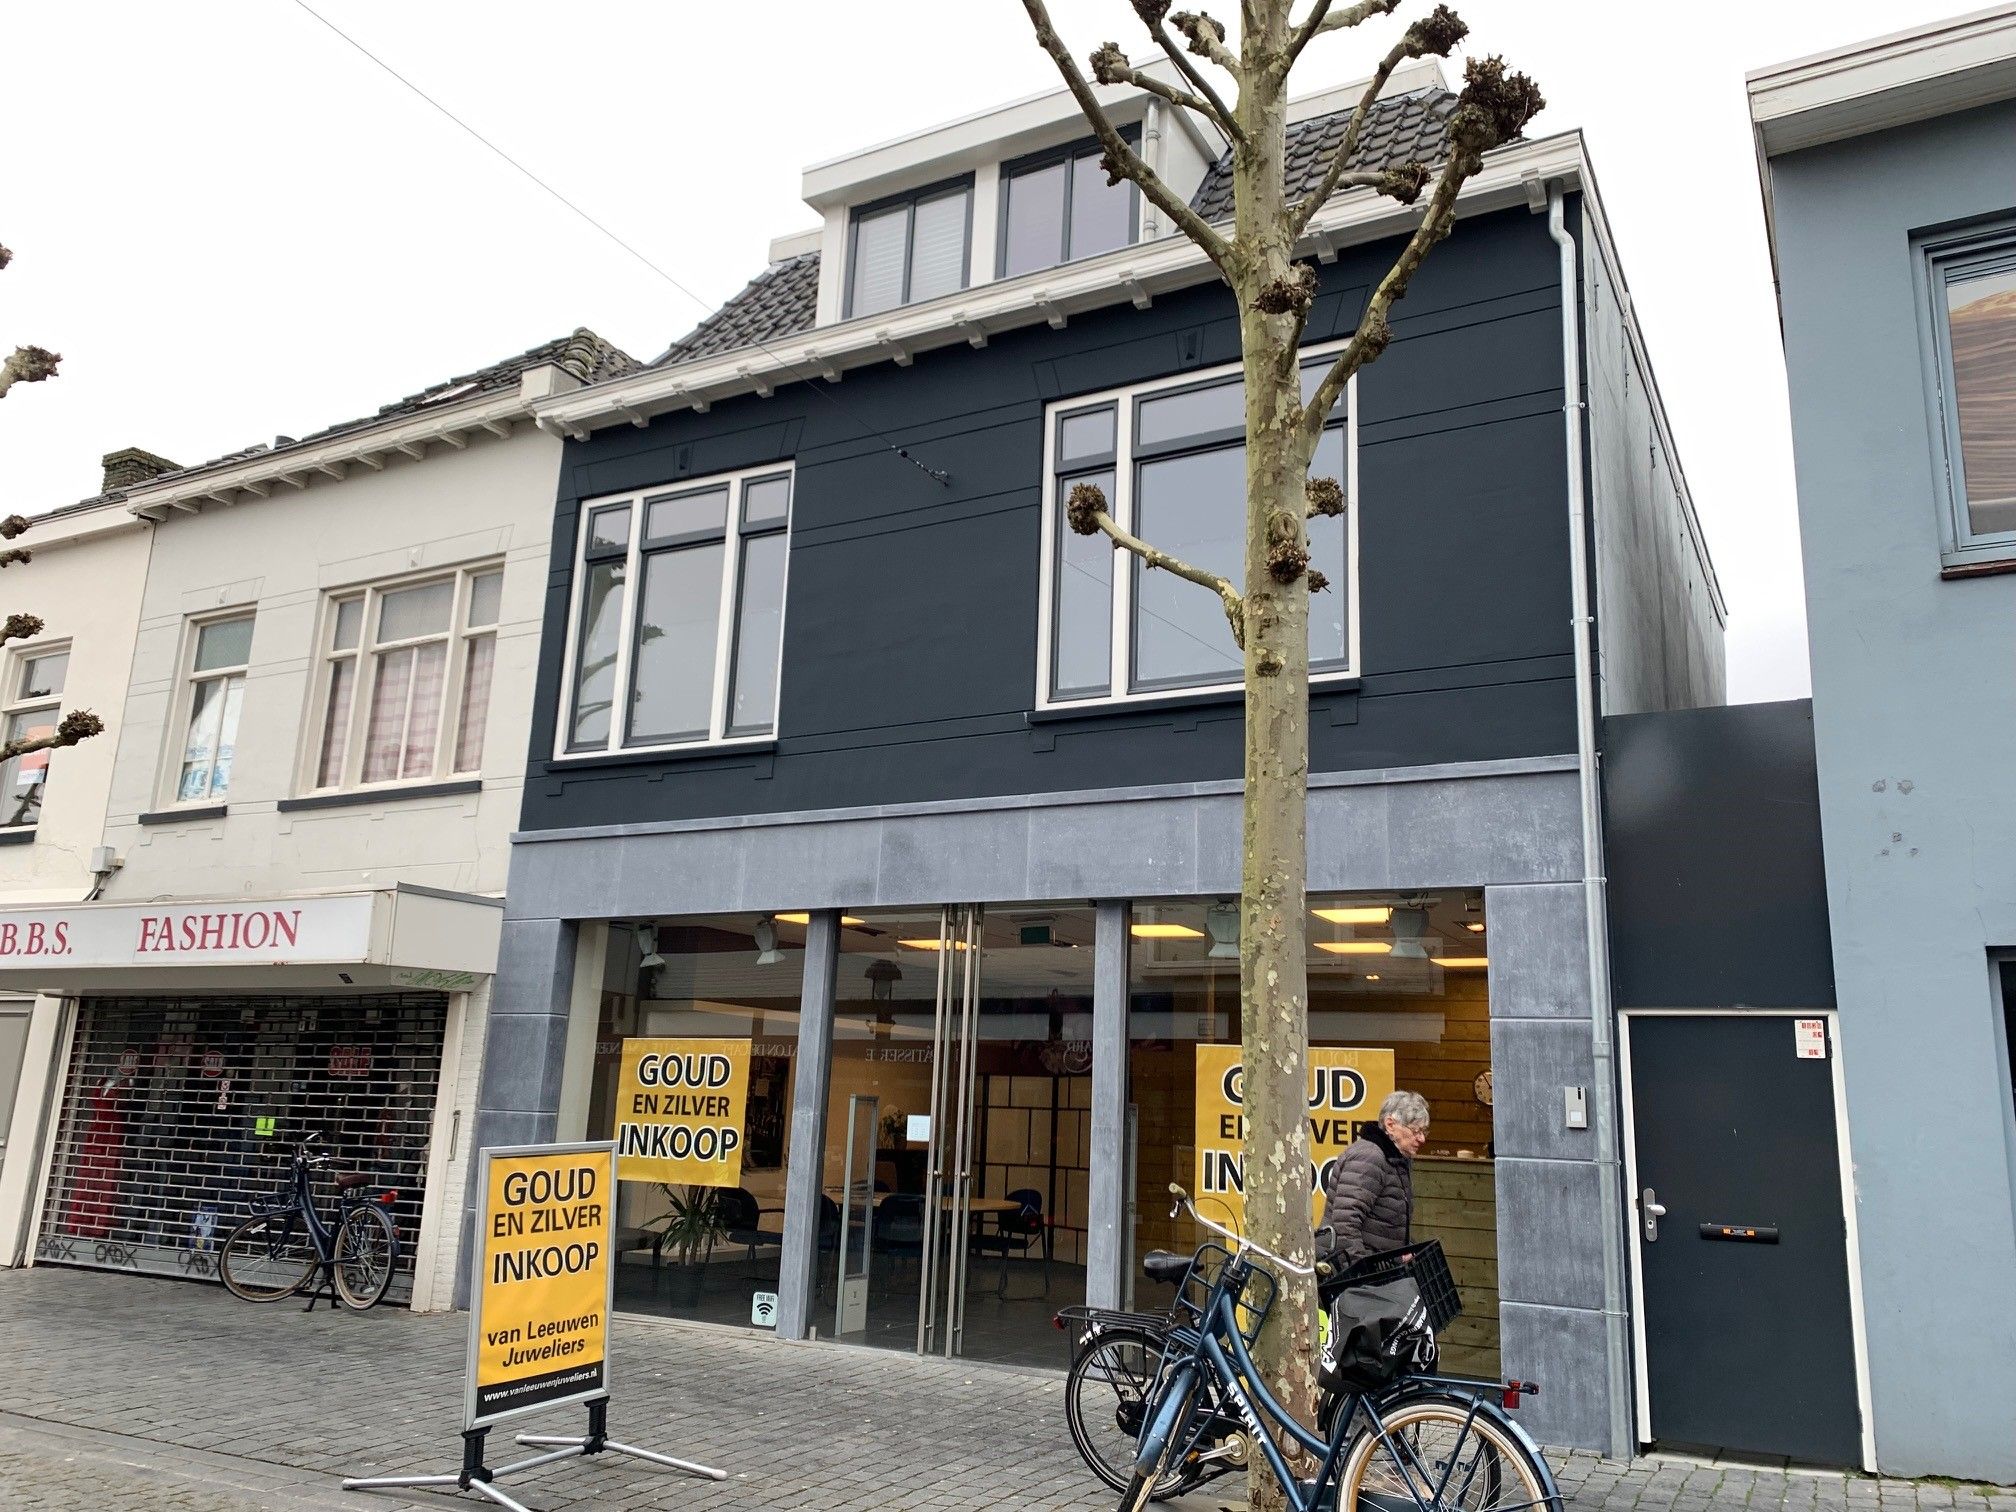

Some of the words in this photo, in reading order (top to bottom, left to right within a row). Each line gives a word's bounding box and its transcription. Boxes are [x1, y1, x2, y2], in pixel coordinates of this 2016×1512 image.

[0, 921, 72, 956] B.B.S.
[137, 911, 302, 952] FASHION
[638, 1053, 732, 1089] GOUD
[1222, 1065, 1366, 1111] GUD
[633, 1094, 658, 1115] EN
[662, 1095, 730, 1117] ZILVER
[618, 1123, 739, 1162] INKOOP
[1220, 1114, 1243, 1140] E
[503, 1167, 597, 1206] GOUD
[493, 1211, 523, 1238] EN
[530, 1204, 602, 1234] ZILVER
[493, 1241, 599, 1284] INKOOP
[487, 1327, 521, 1346] van
[527, 1313, 599, 1340] Leeuwen
[502, 1338, 585, 1367] Juweliers
[484, 1367, 598, 1402] www.vanleeuwenjuweliers.nl
[1227, 1381, 1268, 1445] SPIRIT
